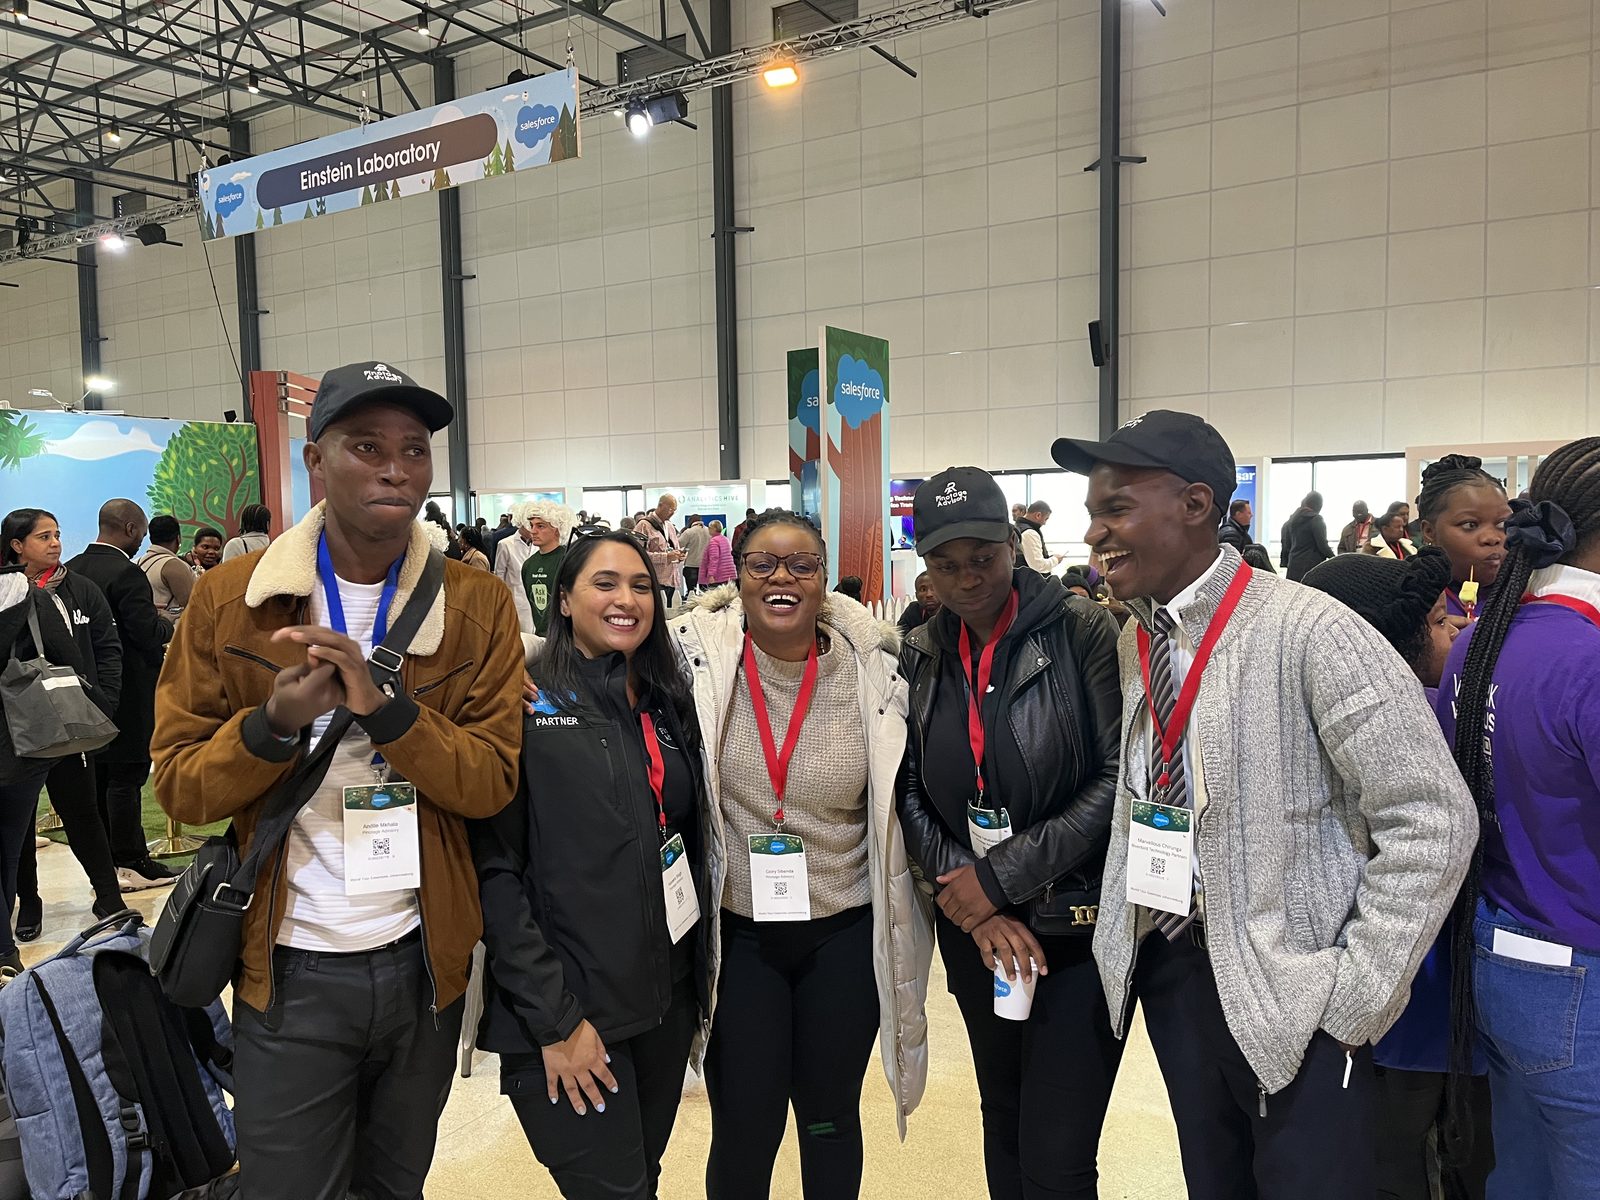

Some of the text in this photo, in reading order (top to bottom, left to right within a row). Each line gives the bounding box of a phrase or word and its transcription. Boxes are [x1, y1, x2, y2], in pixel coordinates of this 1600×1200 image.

[520, 114, 555, 132] salesforce
[300, 140, 441, 191] Einstein Laboratory
[218, 190, 242, 204] salesforce
[841, 380, 880, 401] salesforce
[806, 396, 819, 407] sa
[1236, 472, 1256, 481] sar
[935, 490, 967, 502] Pinotage
[937, 495, 967, 508] Advisory
[535, 587, 546, 596] Ask
[535, 716, 579, 726] PARTNER
